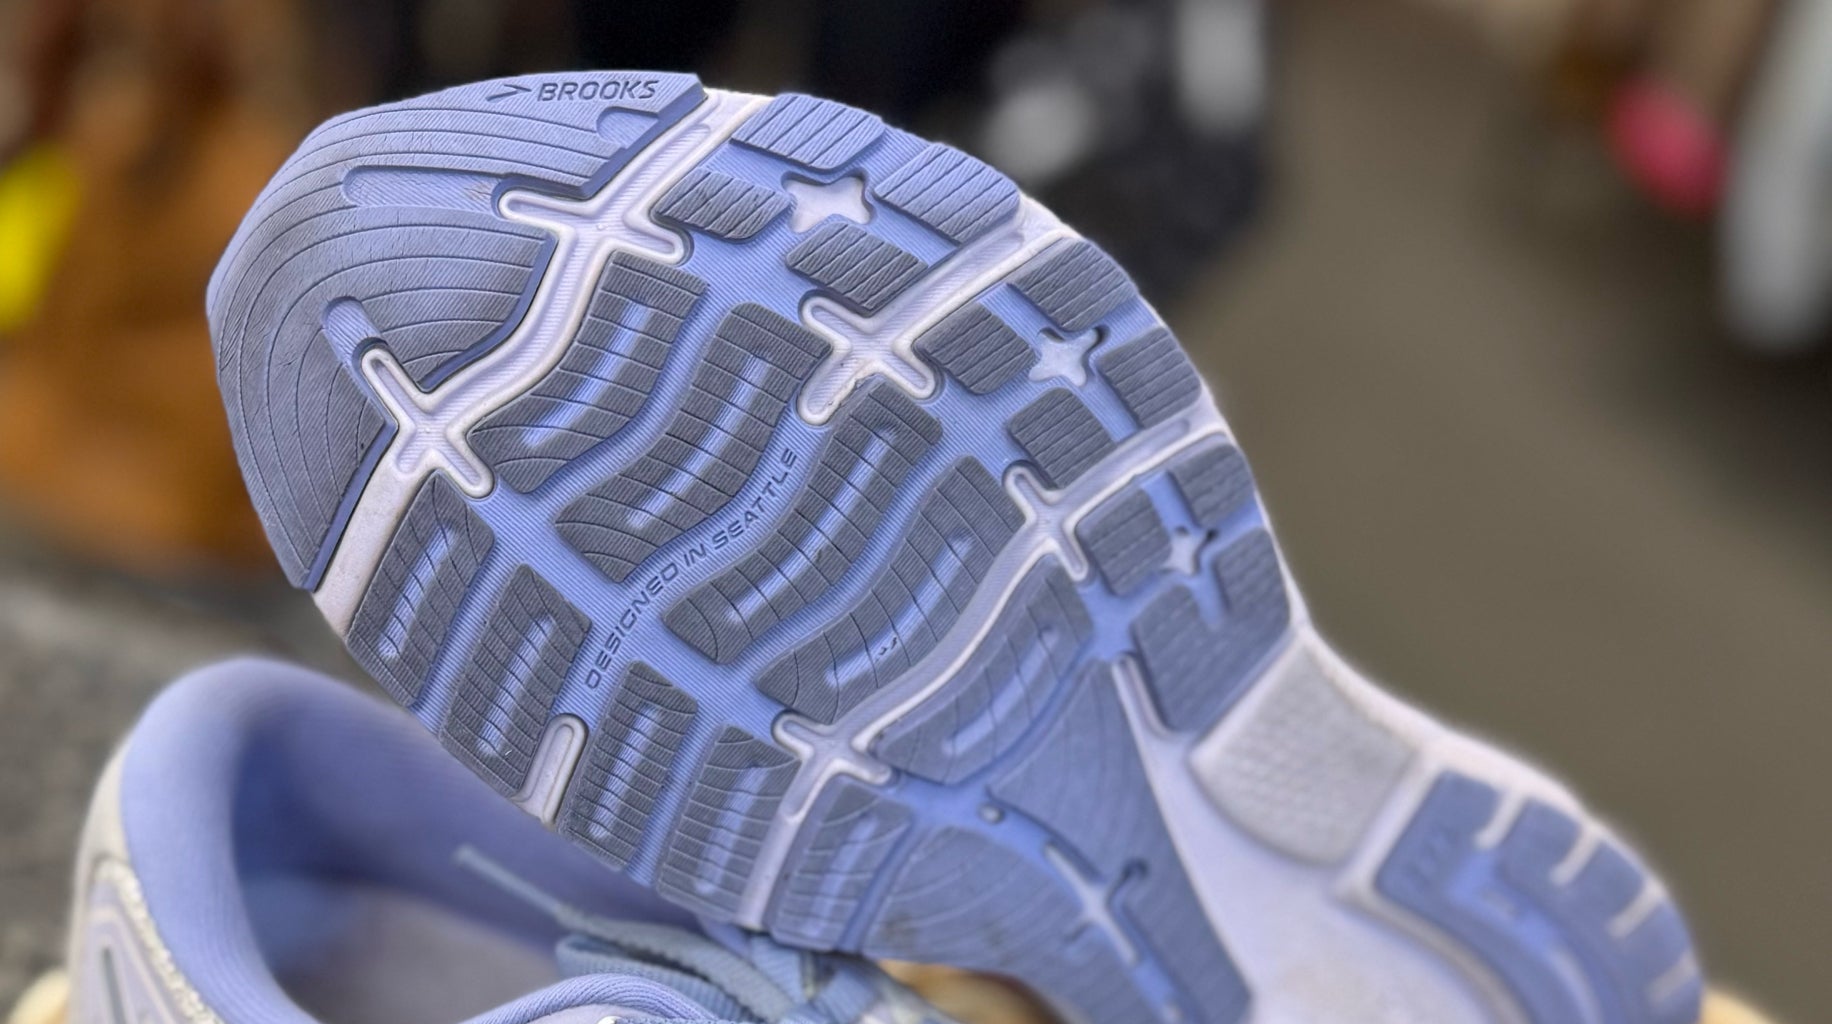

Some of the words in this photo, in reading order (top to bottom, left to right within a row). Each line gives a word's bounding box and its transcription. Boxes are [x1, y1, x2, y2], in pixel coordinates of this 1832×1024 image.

[537, 80, 660, 101] BROOKS
[583, 561, 680, 690] DESIGNED
[683, 544, 707, 567] IN
[711, 448, 798, 550] SEATTLE
